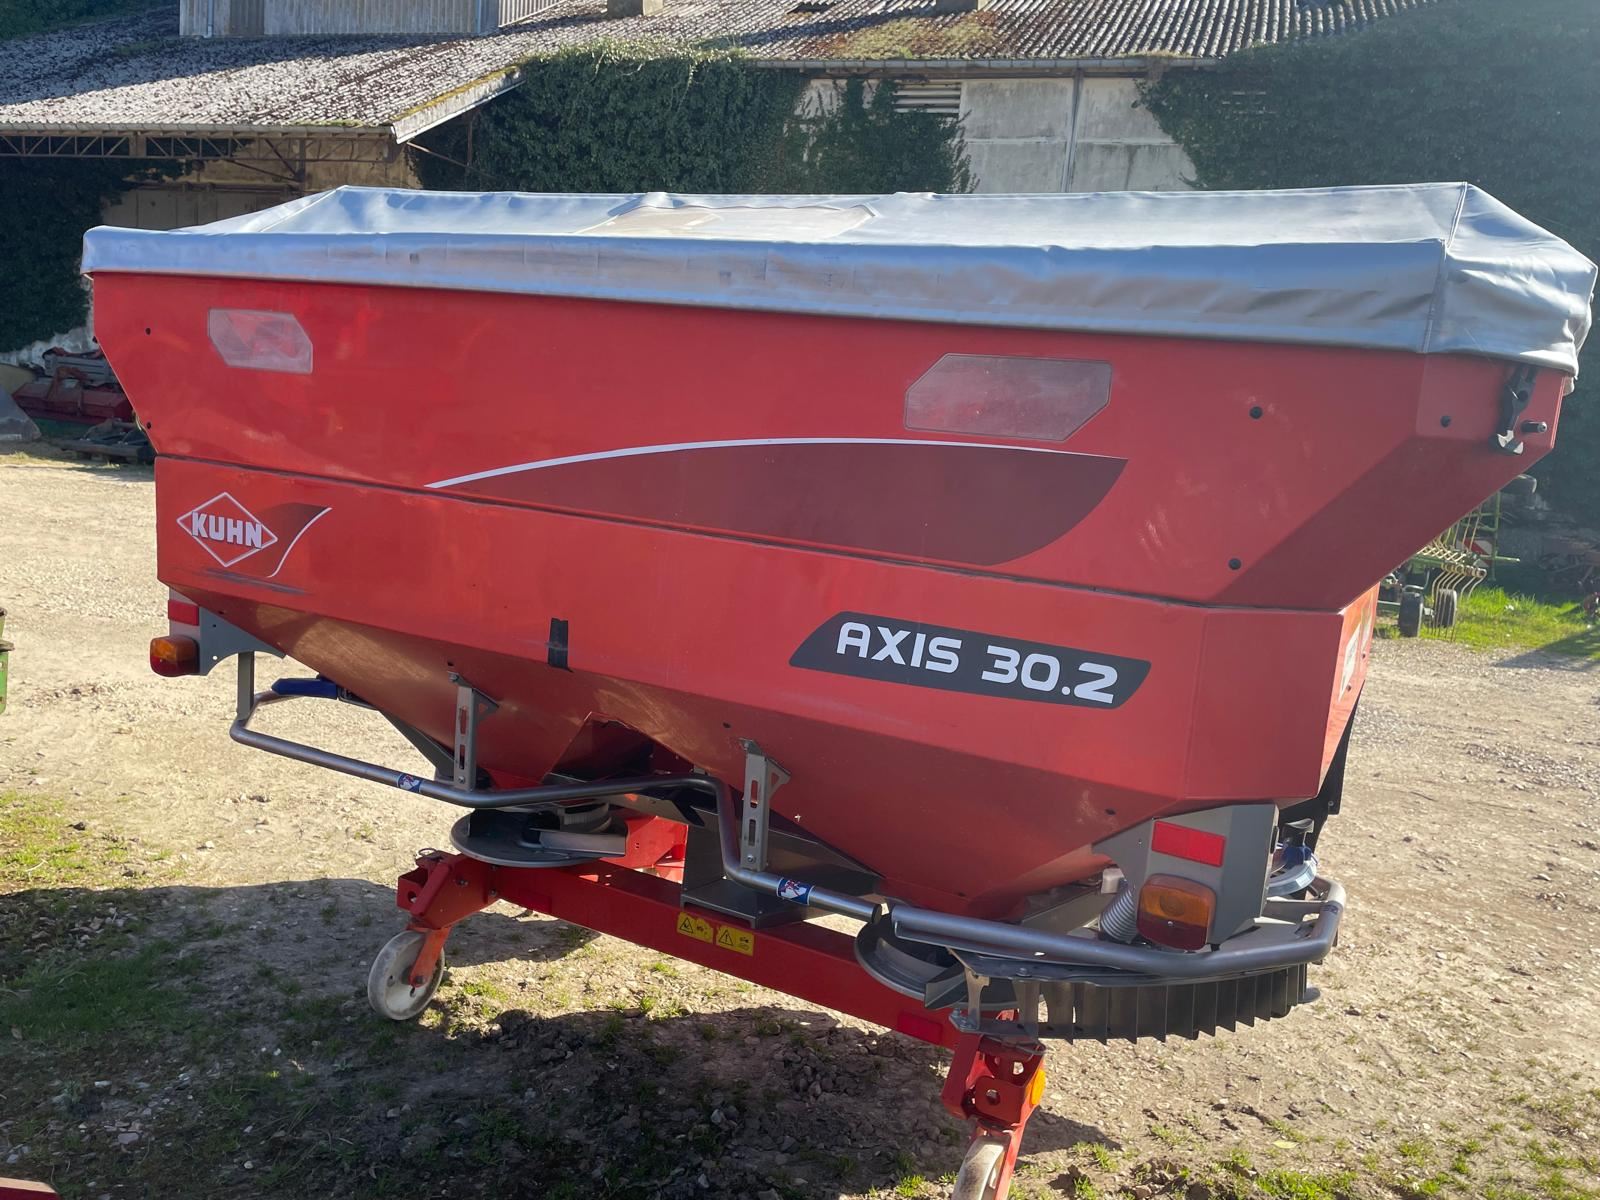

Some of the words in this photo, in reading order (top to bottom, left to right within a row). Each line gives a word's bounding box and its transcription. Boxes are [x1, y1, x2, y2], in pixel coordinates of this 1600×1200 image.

[192, 511, 262, 549] KUHN
[836, 621, 962, 674] AXIS
[981, 645, 1119, 704] 30.2
